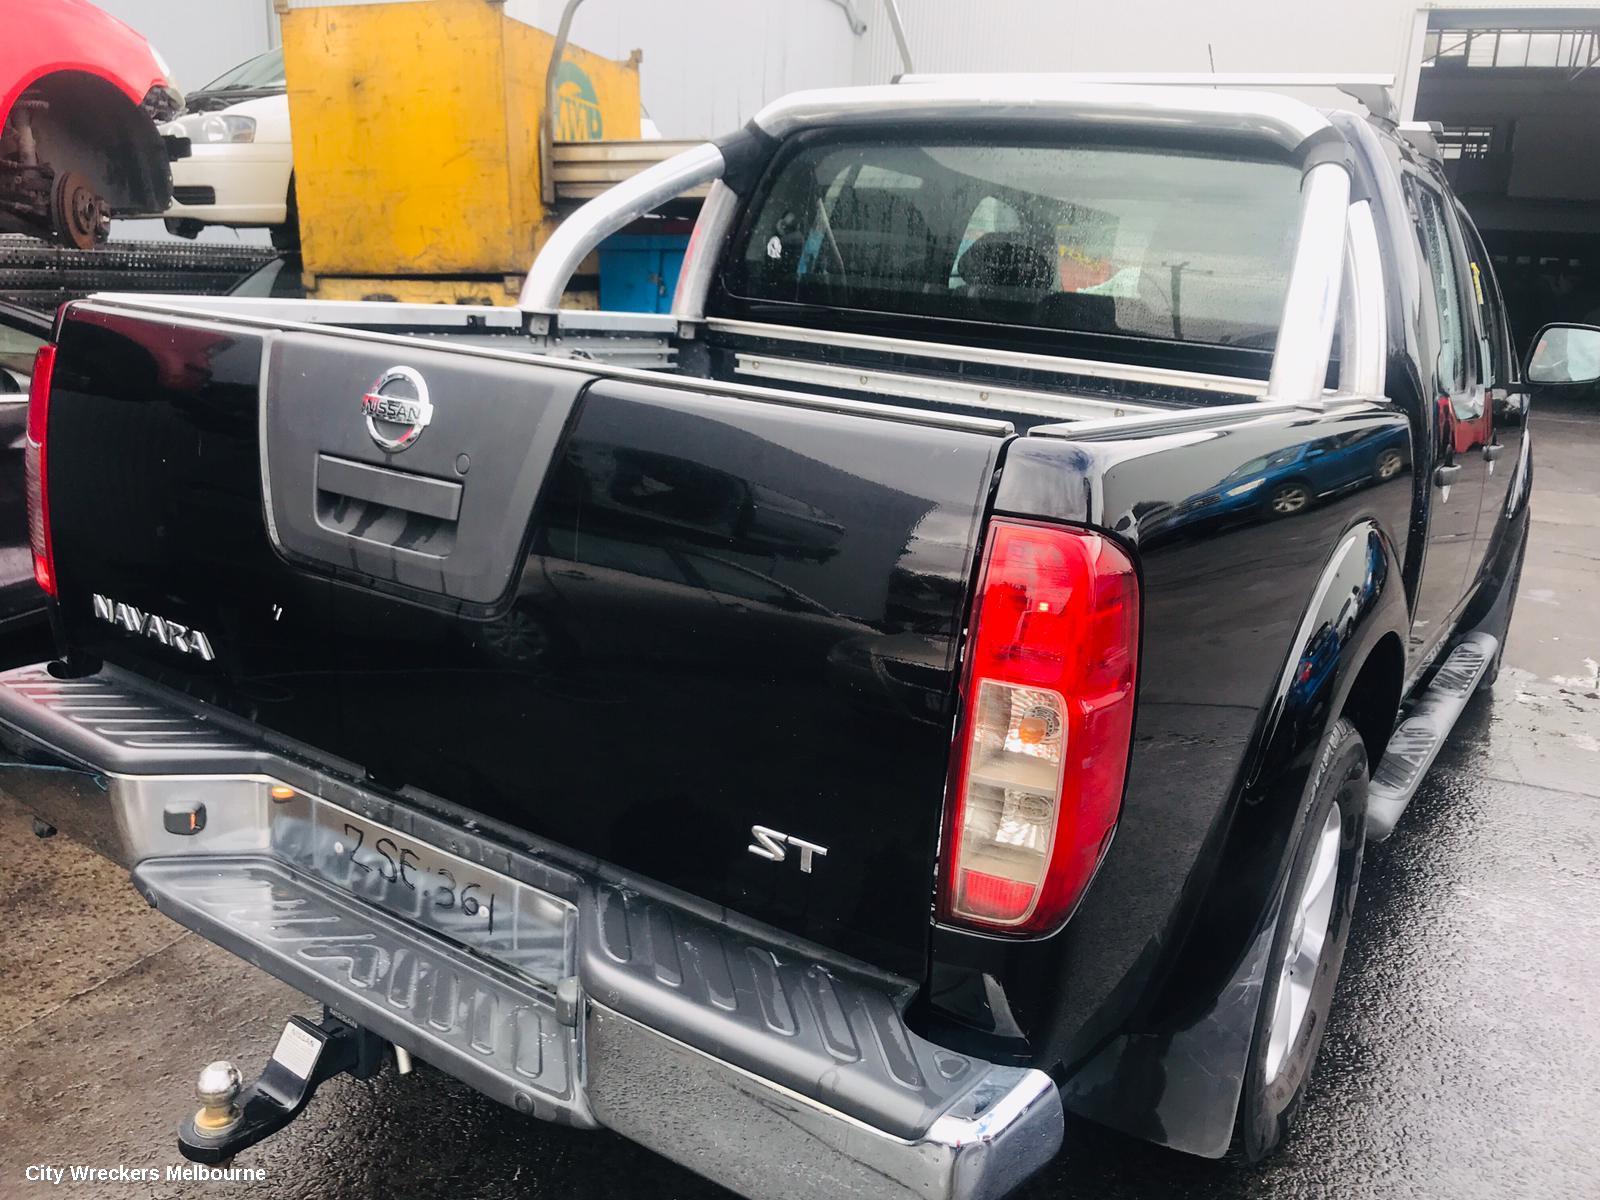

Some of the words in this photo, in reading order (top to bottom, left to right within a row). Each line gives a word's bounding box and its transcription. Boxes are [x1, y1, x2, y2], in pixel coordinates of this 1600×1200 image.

[362, 398, 421, 420] NISSAN
[93, 593, 215, 661] NAVARA
[748, 825, 828, 873] ST
